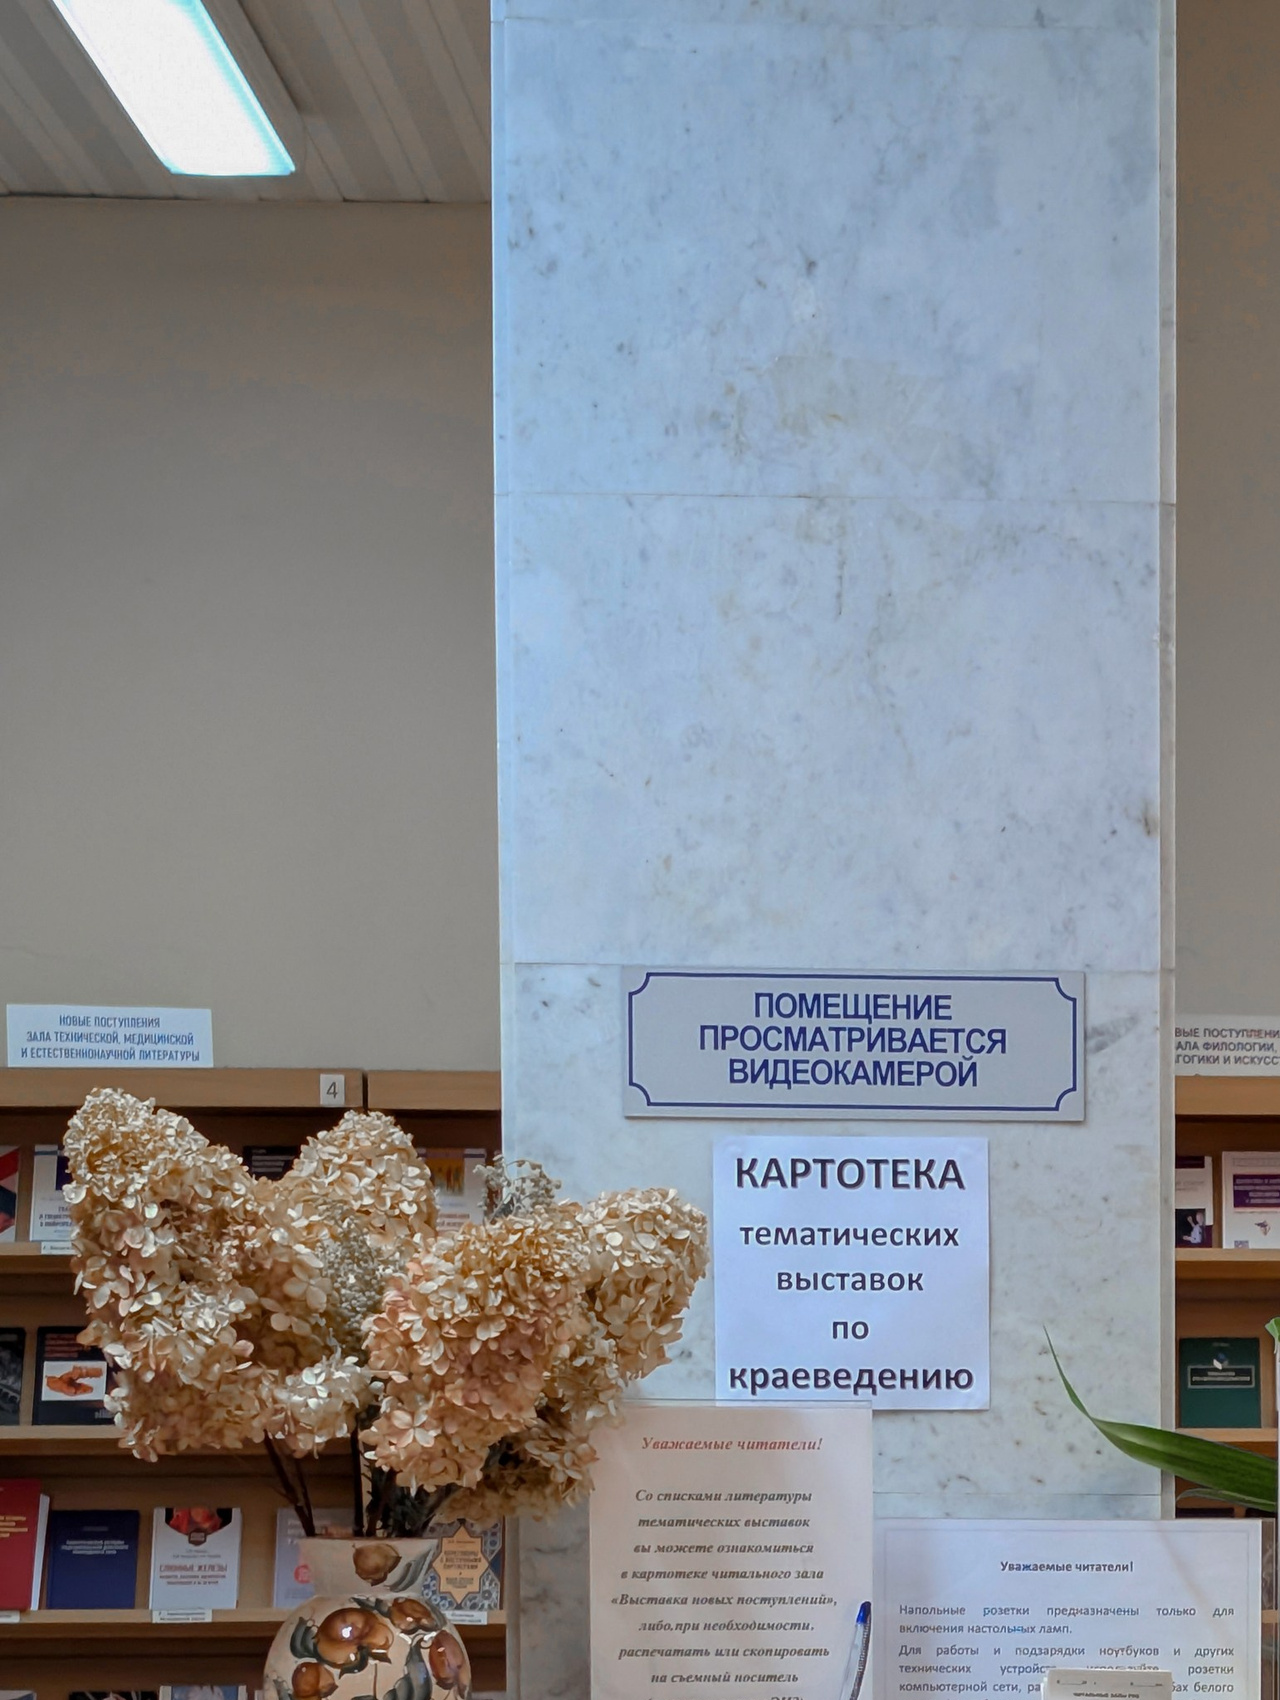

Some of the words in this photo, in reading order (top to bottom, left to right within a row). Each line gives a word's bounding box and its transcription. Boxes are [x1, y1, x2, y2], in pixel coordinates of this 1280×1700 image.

[754, 993, 951, 1024] ПОМЕЩЕНИЕ
[60, 1015, 91, 1027] НОВЫЕ
[95, 1016, 160, 1028] ПОСТУПЛЕНИЯ
[1175, 1027, 1200, 1037] ВЫЕ
[27, 1031, 51, 1042] ЗАЛА
[124, 1033, 193, 1048] МЕДИЦИНСКОЙ
[700, 1025, 1006, 1054] ПРОСМАТРИВАЕТСЯ
[21, 1047, 27, 1058] И
[31, 1044, 138, 1060] ЕСТЕСТВЕННОНАУЧНОЙ
[139, 1050, 199, 1061] ЛИТЕРАТУРЫ
[1175, 1041, 1199, 1051] АЛА
[1203, 1042, 1277, 1053] ФИЛОЛОГИИ,
[1175, 1054, 1219, 1064] ГОГИКИ
[1223, 1056, 1230, 1064] И
[729, 1056, 978, 1089] ВИДЕОКАМЕРОЙ
[326, 1082, 338, 1098] 4
[737, 1158, 965, 1190] КАРТОТЕКА
[740, 1227, 958, 1246] тематических
[778, 1272, 923, 1291] выставок
[833, 1321, 868, 1339] по
[730, 1368, 973, 1396] краеведению
[642, 1437, 733, 1449] Уважаемые
[738, 1438, 822, 1450] читатели!
[636, 1490, 653, 1501] Со
[657, 1493, 722, 1501] списками
[724, 1493, 812, 1504] литературы
[638, 1519, 741, 1527] тематических
[744, 1519, 810, 1527] выставок
[634, 1545, 651, 1553] вы
[655, 1545, 713, 1553] можете
[717, 1545, 813, 1553] ознакомиться
[1001, 1561, 1072, 1571] Уважаемые
[1076, 1561, 1133, 1572] читатели!
[621, 1571, 628, 1579] в
[632, 1571, 708, 1582] картотеке
[712, 1571, 791, 1579] читального
[795, 1571, 824, 1579] зала
[611, 1594, 688, 1605] «Выставка
[692, 1597, 733, 1605] новых
[736, 1594, 837, 1608] поступлений»,
[900, 1605, 965, 1615] Напольные
[983, 1607, 1029, 1617] розетки
[1047, 1608, 1139, 1617] предназначены
[1156, 1608, 1196, 1616] только
[1213, 1608, 1234, 1618] для
[900, 1625, 963, 1633] включения
[968, 1625, 1036, 1633] настольных
[618, 1649, 710, 1660] распечатать
[743, 1648, 829, 1659] скопировать
[899, 1645, 921, 1657] Для
[936, 1644, 978, 1657] работы
[1016, 1648, 1085, 1657] подзарядки
[1100, 1645, 1159, 1657] ноутбуков
[1174, 1648, 1180, 1656] и
[1194, 1648, 1234, 1658] других
[899, 1665, 971, 1673] технических
[1000, 1663, 1056, 1676] устройс
[1188, 1666, 1233, 1676] розетки
[671, 1672, 730, 1682] съемный
[735, 1674, 798, 1682] носитель
[899, 1681, 987, 1693] компьютерной
[993, 1684, 1021, 1693] сети,
[1194, 1682, 1234, 1692] белого
